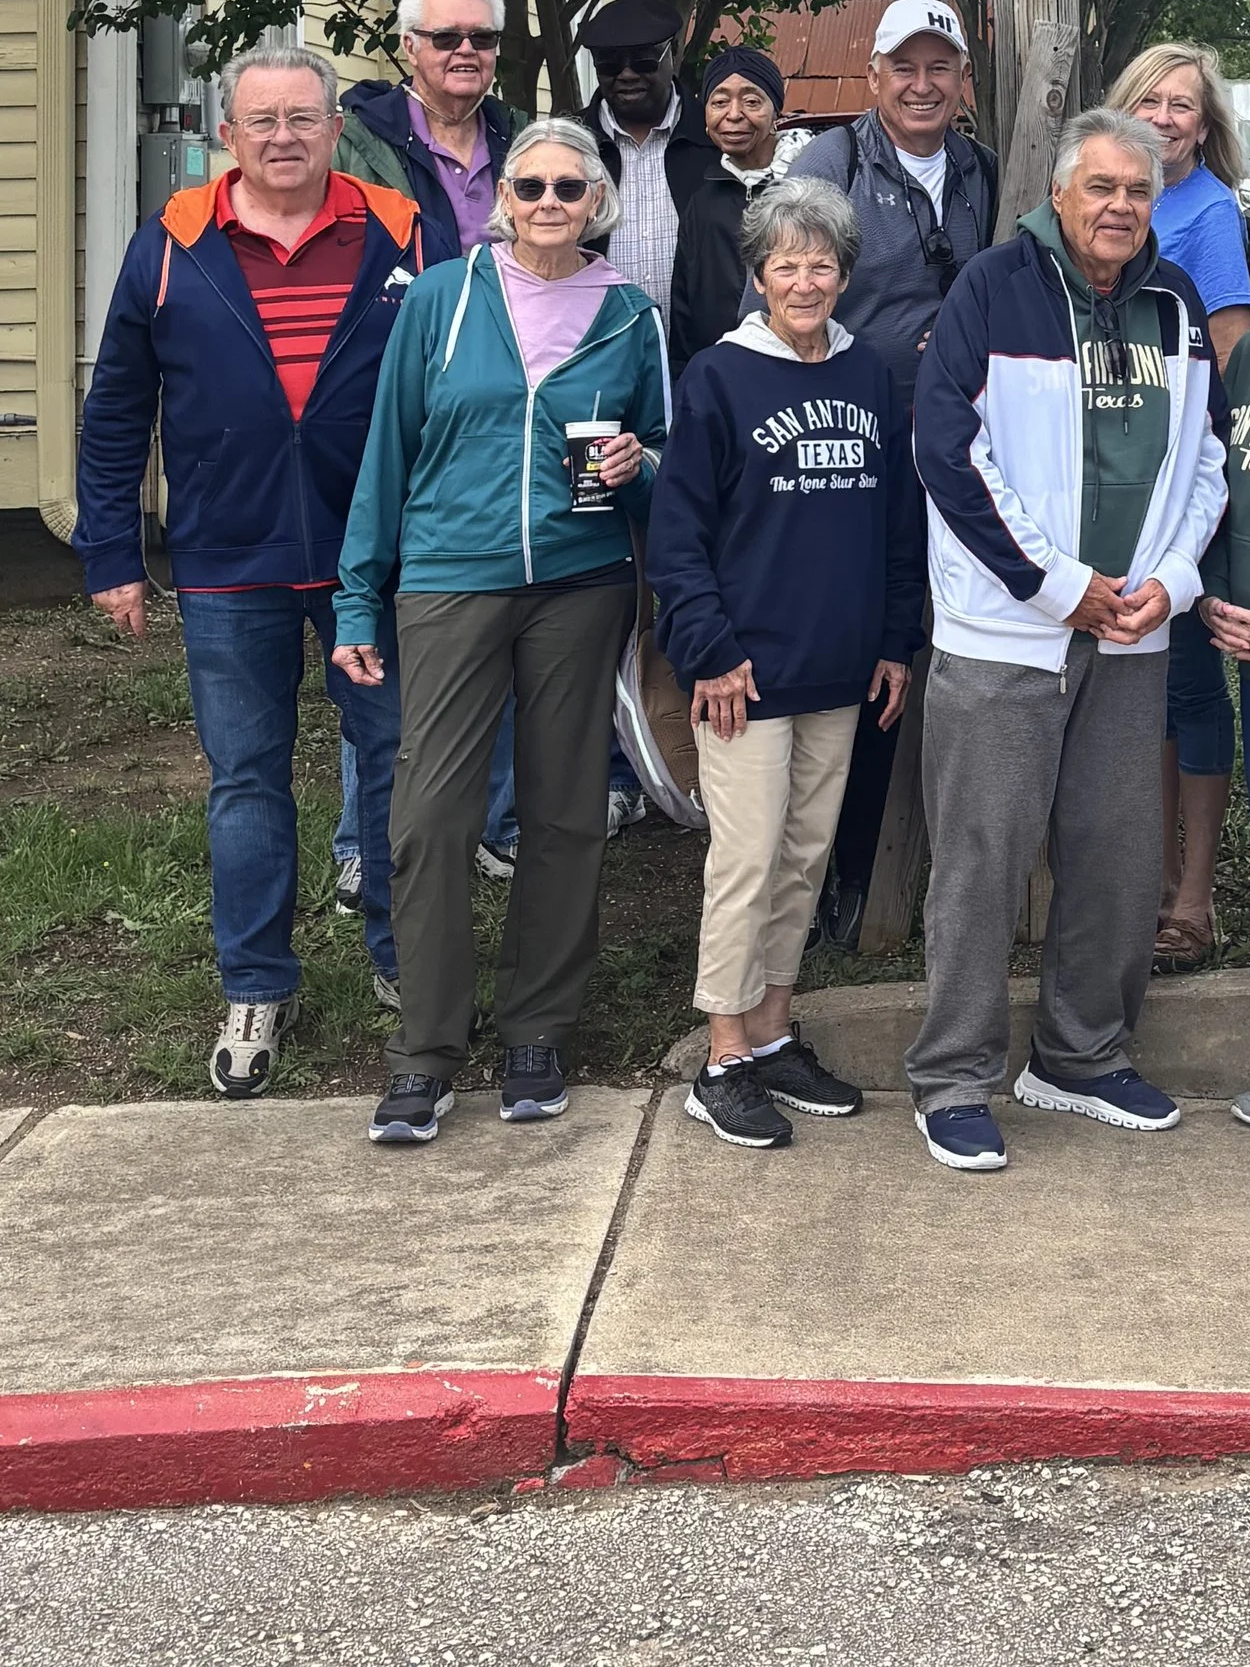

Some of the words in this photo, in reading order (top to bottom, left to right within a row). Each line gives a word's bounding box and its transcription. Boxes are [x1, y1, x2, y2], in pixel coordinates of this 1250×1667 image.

[751, 407, 805, 454] SAN
[800, 442, 862, 467] TEXAS
[769, 476, 796, 493] The
[798, 474, 828, 494] Lone
[829, 473, 856, 490] Star
